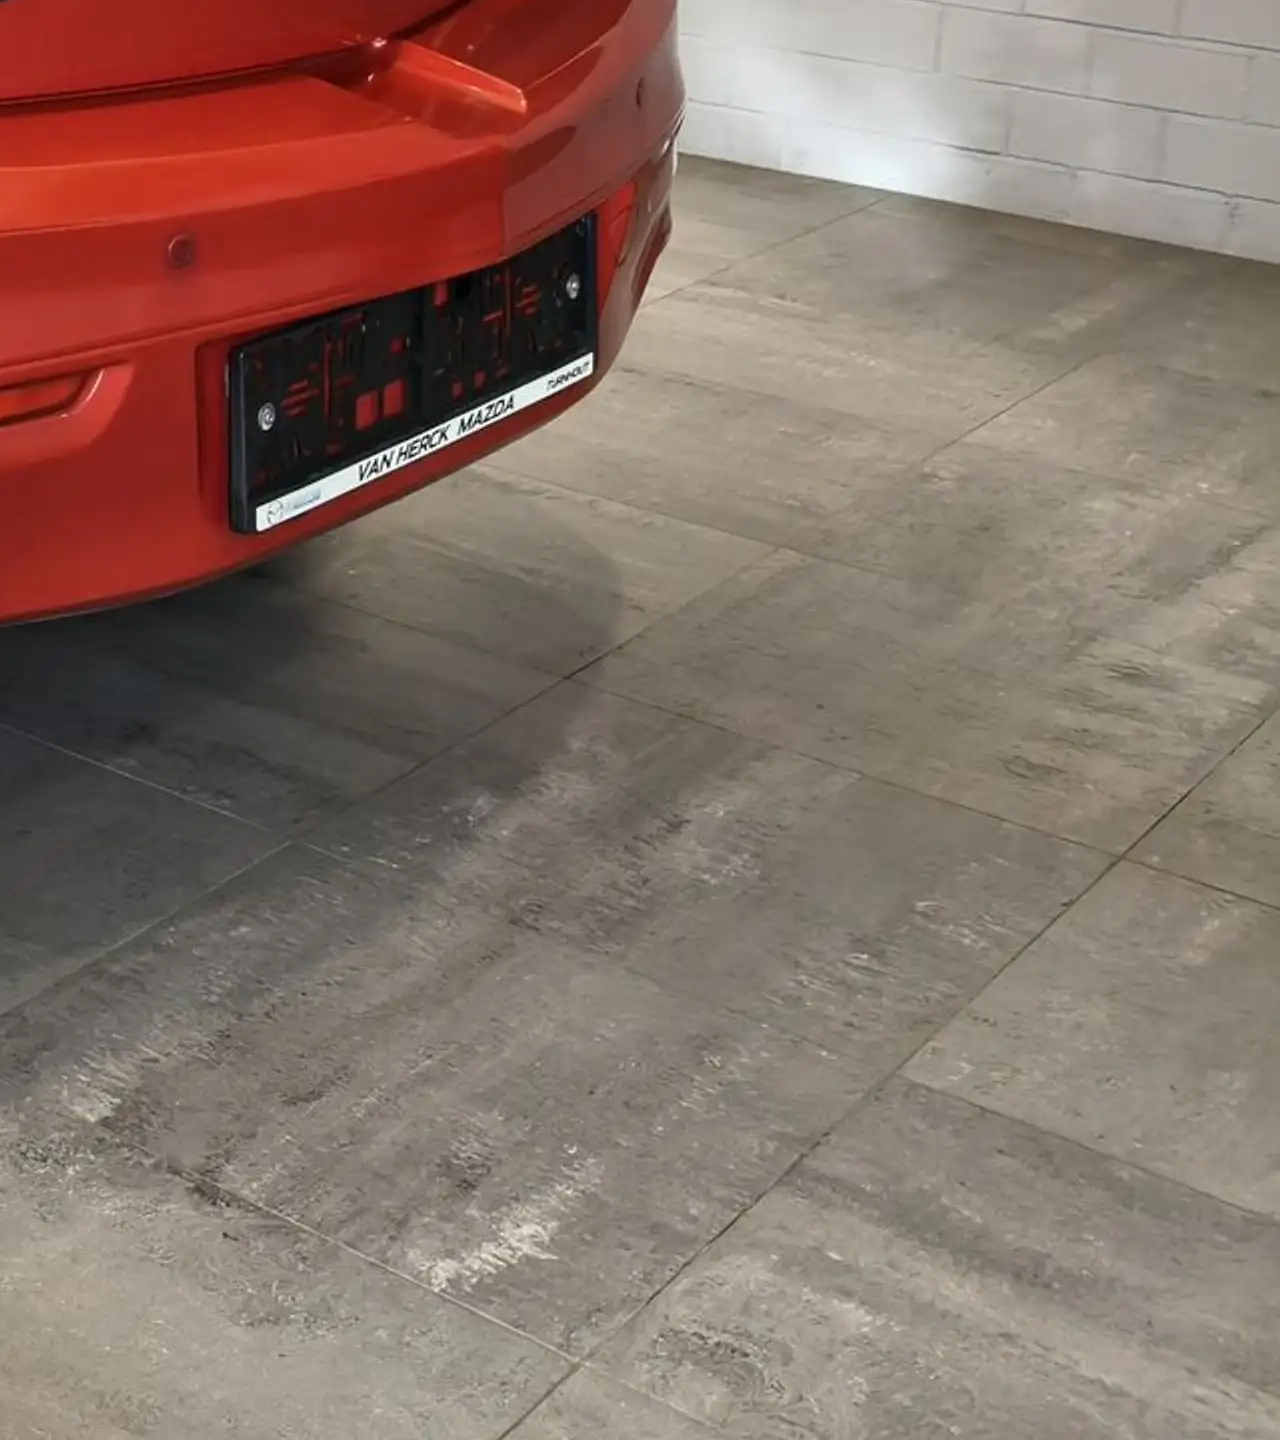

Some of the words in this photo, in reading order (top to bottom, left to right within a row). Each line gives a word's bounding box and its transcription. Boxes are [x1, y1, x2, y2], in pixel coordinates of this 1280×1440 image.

[358, 449, 394, 481] VAN
[395, 423, 452, 463] HERCK
[457, 394, 515, 436] MAZDA
